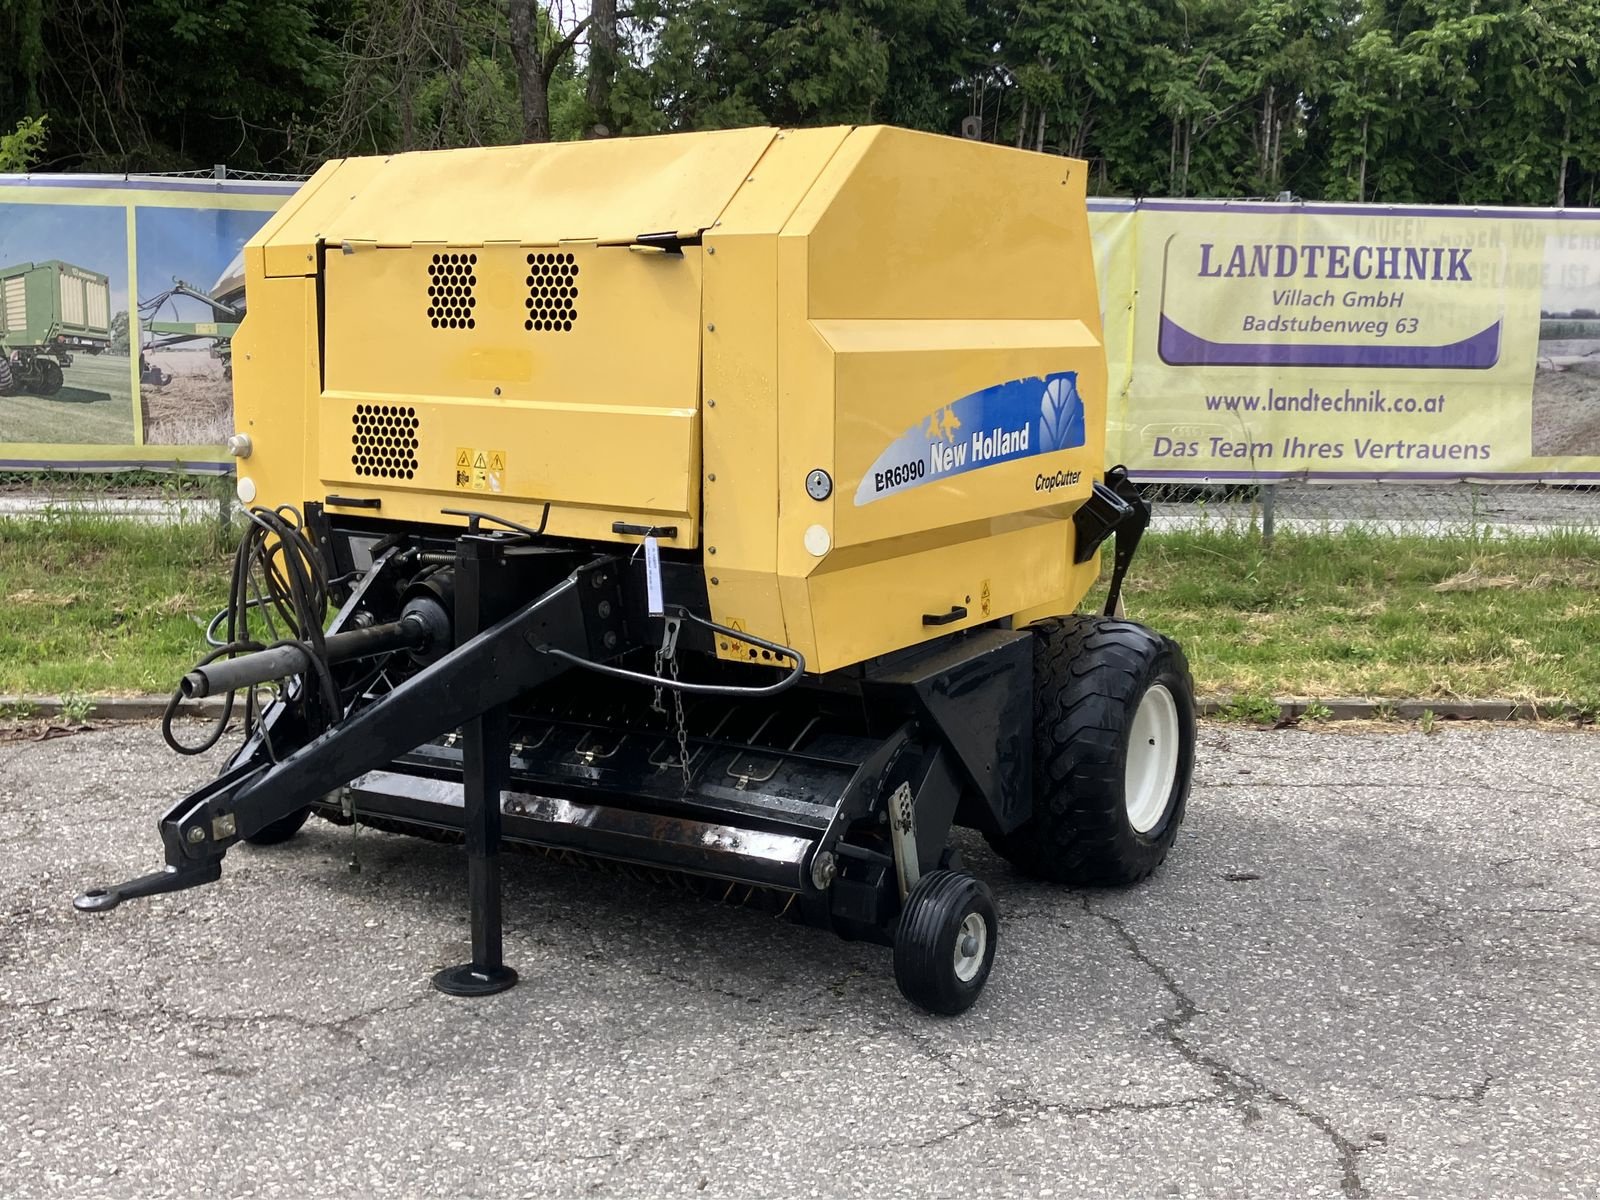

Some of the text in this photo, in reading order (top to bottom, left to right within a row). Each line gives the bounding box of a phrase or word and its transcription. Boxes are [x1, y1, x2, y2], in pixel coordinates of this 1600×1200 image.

[1198, 243, 1473, 282] LANDTECHNIK
[1272, 289, 1404, 309] Villach GmbH
[1242, 314, 1419, 338] Badstubenweg 63
[1205, 387, 1446, 414] www.landtechnik.co.at
[874, 421, 1031, 493] BR6090 New Holland
[1152, 436, 1492, 461] Das Team Ihres Vertrauens
[1034, 469, 1083, 494] CropCutter
